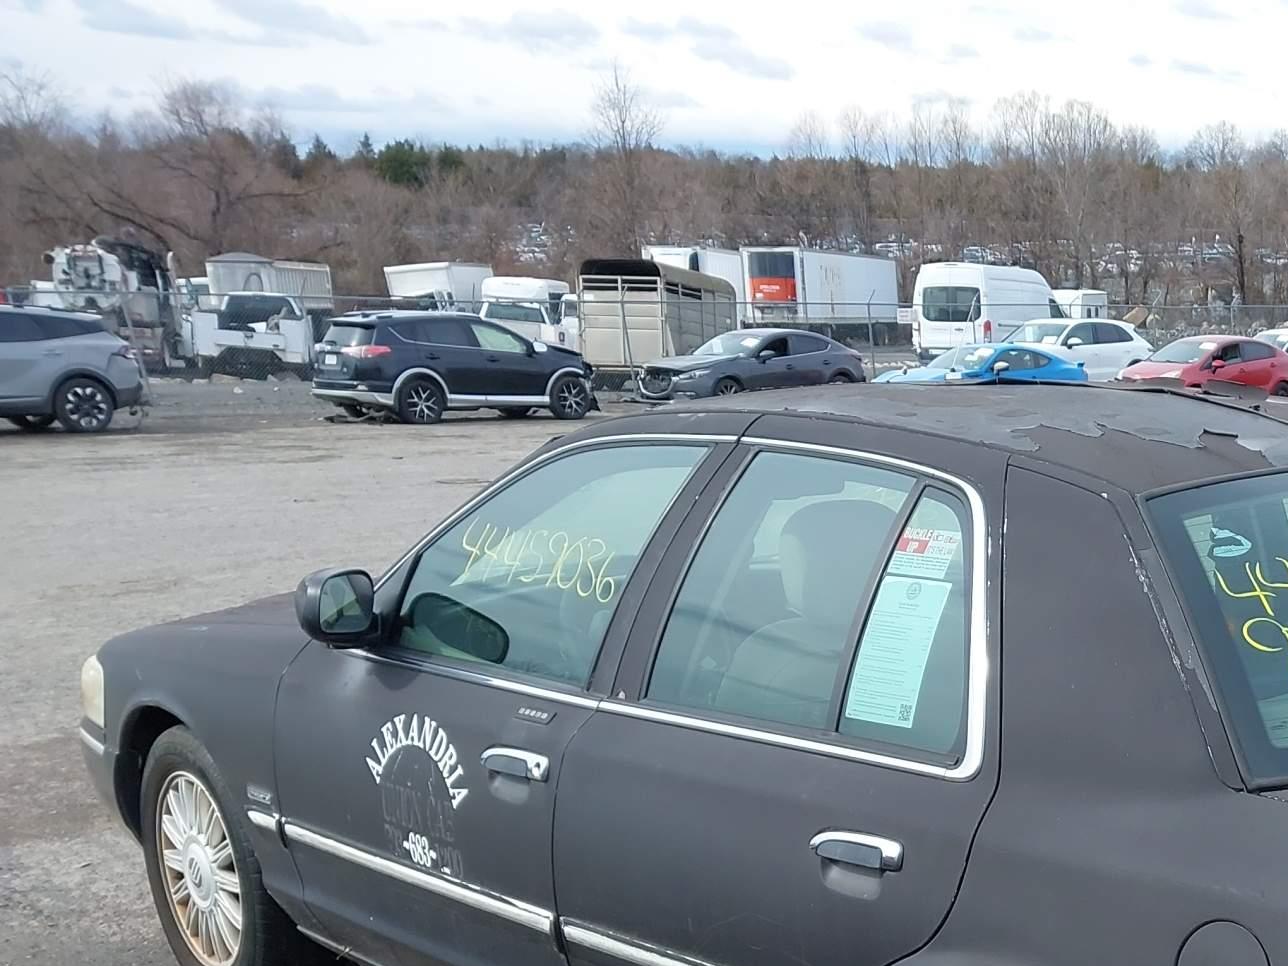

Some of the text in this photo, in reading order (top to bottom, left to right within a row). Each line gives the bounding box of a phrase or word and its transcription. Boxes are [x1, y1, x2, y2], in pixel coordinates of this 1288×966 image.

[462, 514, 616, 603] 44459036
[904, 527, 932, 540] BUCKLE
[365, 712, 470, 809] ALEXANDRIA
